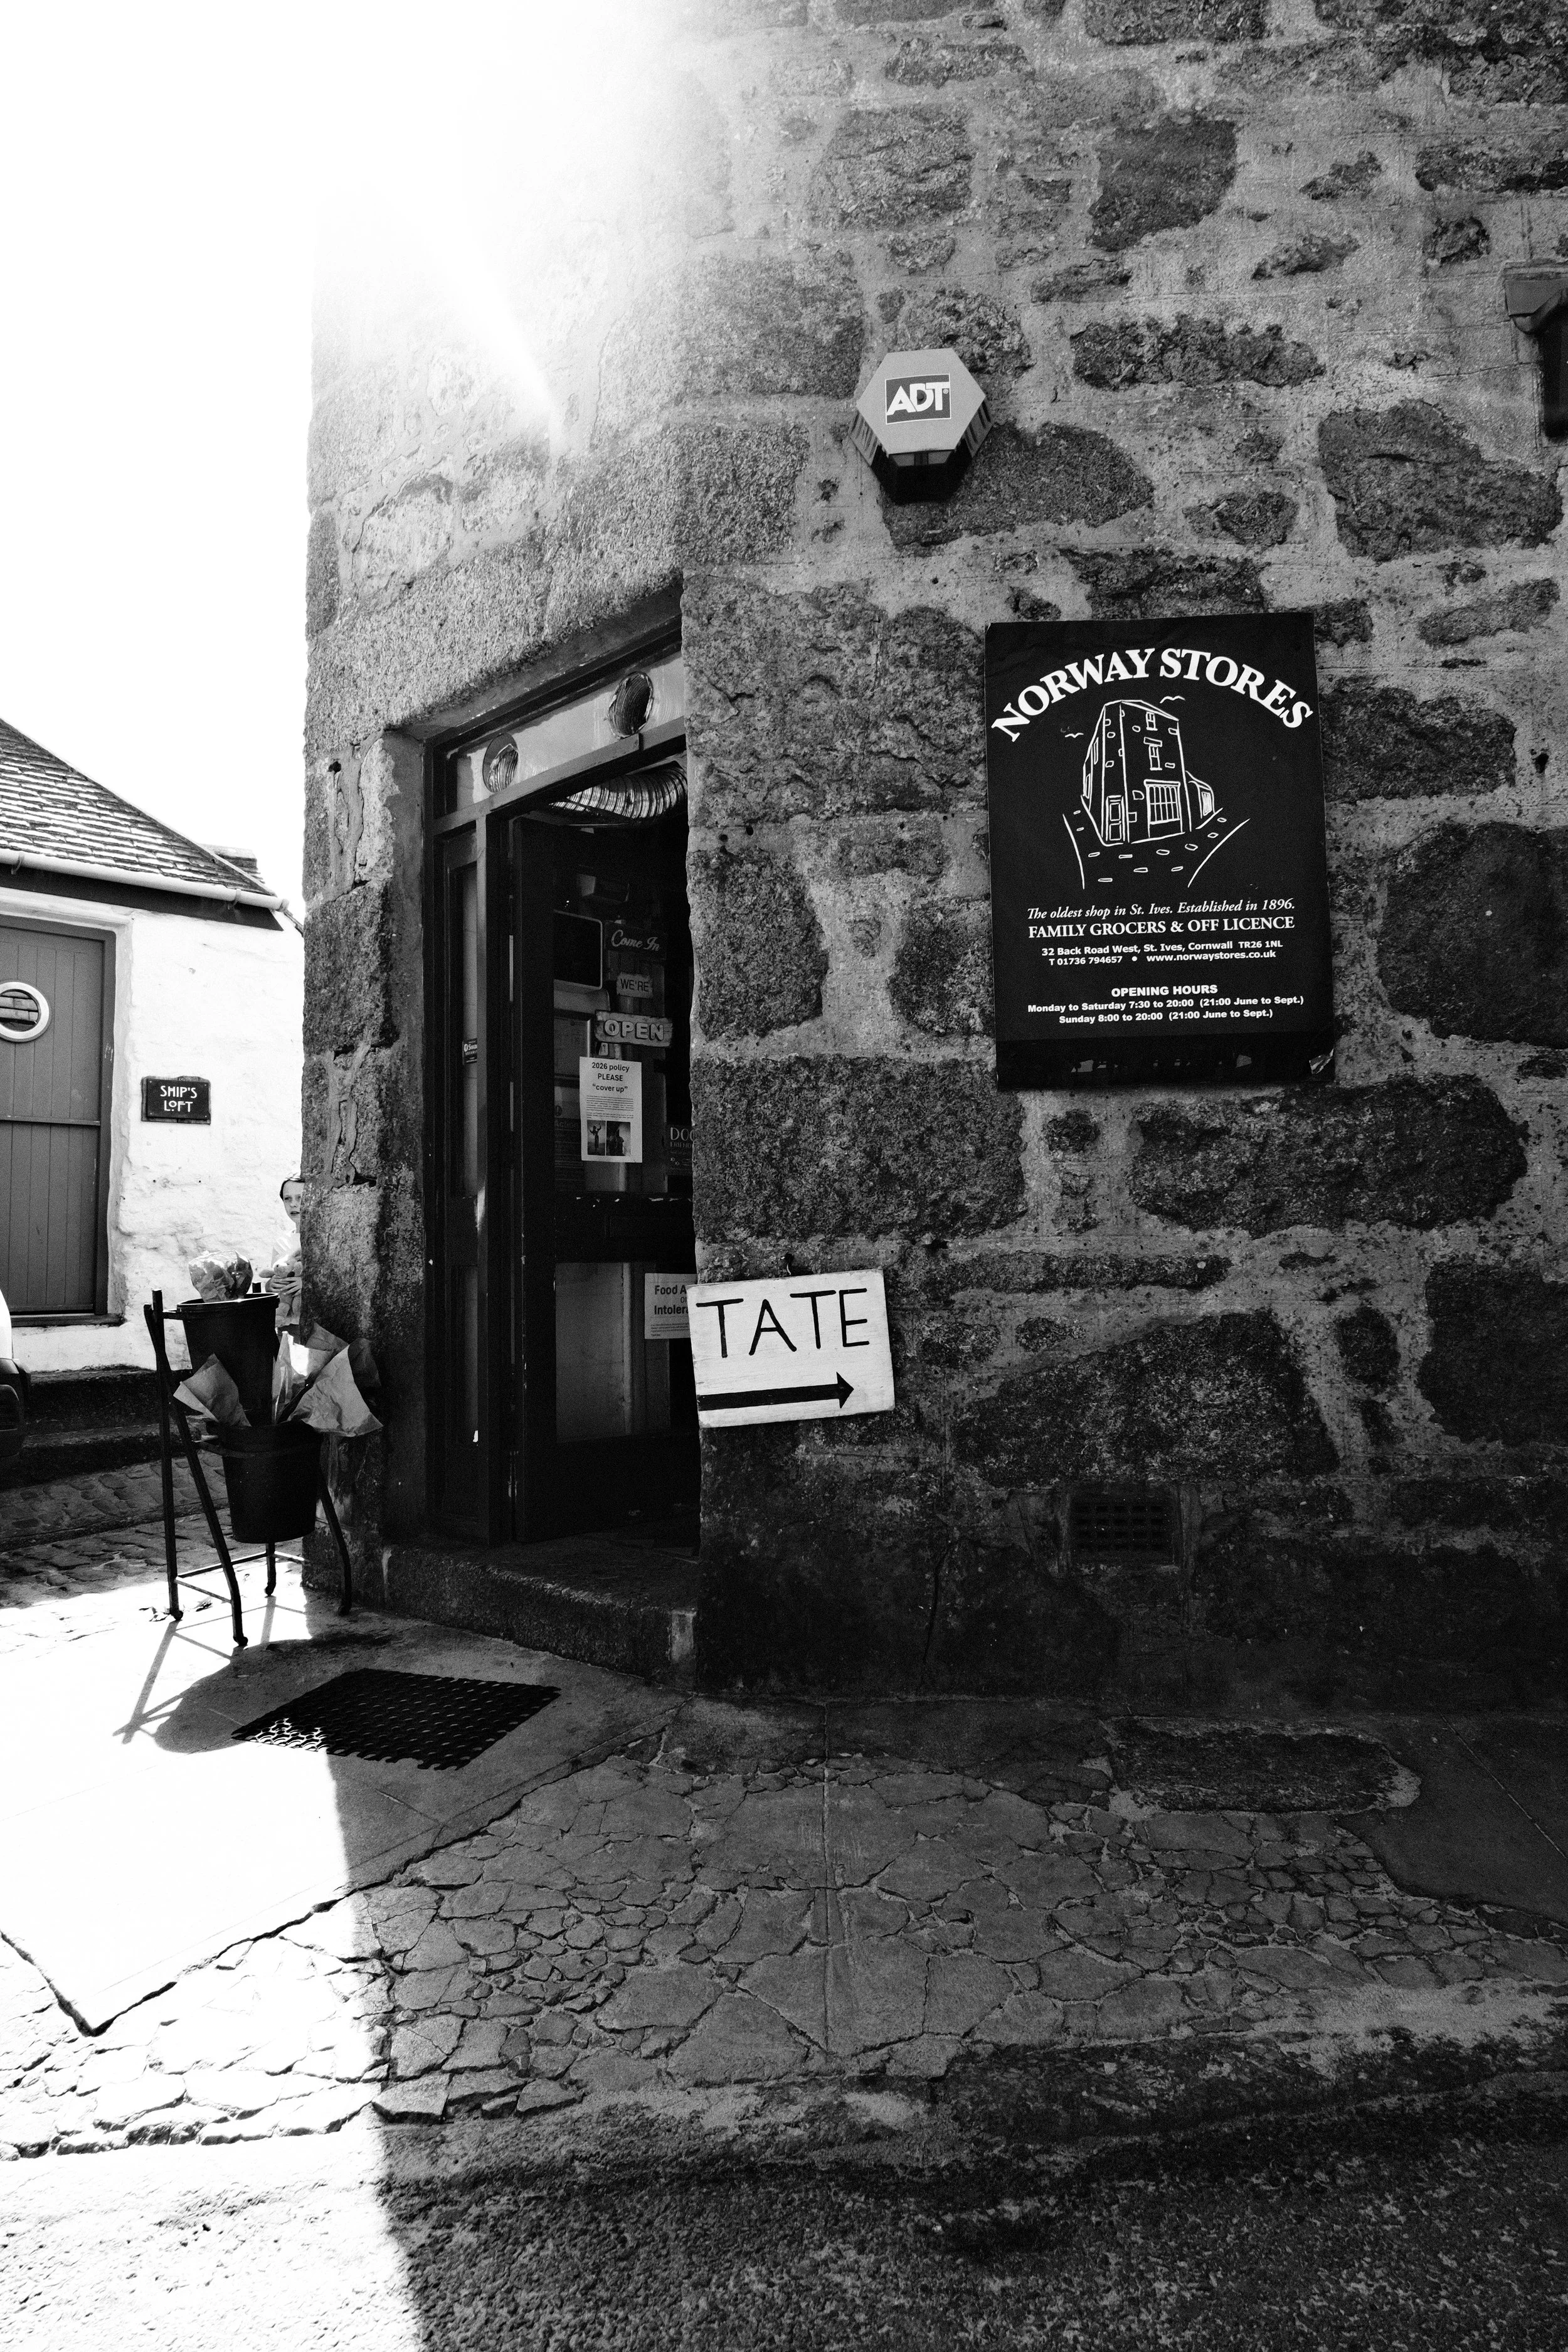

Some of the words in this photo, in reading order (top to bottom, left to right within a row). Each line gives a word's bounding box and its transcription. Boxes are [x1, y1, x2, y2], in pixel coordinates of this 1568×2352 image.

[886, 381, 950, 415] ADT
[991, 648, 1155, 742] NORWAY
[1159, 648, 1313, 728] STORES
[1027, 907, 1047, 919] The
[1049, 906, 1083, 918] oldest
[1084, 904, 1111, 920] shop
[1114, 905, 1126, 916] in
[1130, 903, 1145, 915] St.
[1148, 903, 1173, 914] Ives.
[1177, 899, 1244, 913] Established
[1245, 900, 1258, 911] in
[1261, 898, 1295, 911] 1896.
[1028, 924, 1087, 938] FAMILY
[1089, 920, 1167, 936] GROCERS
[1170, 921, 1185, 933] &
[1187, 919, 1219, 932] OFF
[1222, 916, 1295, 931] LICENCE
[610, 929, 644, 948] Come
[644, 936, 661, 952] In
[1041, 947, 1055, 956] 32
[1057, 946, 1082, 956] Back
[1084, 945, 1110, 955] Road
[1111, 945, 1141, 954] West,
[1143, 944, 1158, 952] St.
[1160, 943, 1185, 952] Ives,
[1188, 940, 1233, 951] Cornwall
[1237, 940, 1263, 949] TR26
[1264, 940, 1283, 948] 1NL
[1057, 956, 1086, 966] 01736
[1088, 955, 1123, 965] 794657
[1146, 950, 1276, 962] www.norwaystores.co.uk
[620, 978, 650, 992] WE'RE
[1111, 986, 1170, 997] OPENING
[1172, 984, 1218, 995] HOURS
[1027, 1004, 1066, 1014] Monday
[1068, 1003, 1079, 1011] to
[1081, 1002, 1126, 1011] Saturday
[1128, 1000, 1151, 1009] 7:30
[1166, 999, 1194, 1007] 20:00
[1199, 997, 1231, 1008] (21:00
[1233, 997, 1259, 1005] June
[1260, 997, 1272, 1005] to
[1274, 995, 1304, 1005] Sept.)
[1059, 1015, 1096, 1024] Sunday
[1098, 1014, 1120, 1022] 8:00
[1121, 1014, 1133, 1022] to
[1135, 1012, 1163, 1021] 20:00
[1168, 1010, 1200, 1022] (21:00
[1202, 1010, 1227, 1019] June
[1229, 1010, 1241, 1018] to
[1243, 1009, 1273, 1019] Sept.)
[603, 1019, 665, 1041] OPEN
[609, 1064, 630, 1073] policy
[598, 1073, 623, 1081] PLEASE
[160, 1085, 198, 1099] SHIP'S
[654, 1285, 677, 1295] Food
[654, 1305, 689, 1315] Intolera
[696, 1288, 869, 1358] TATE
